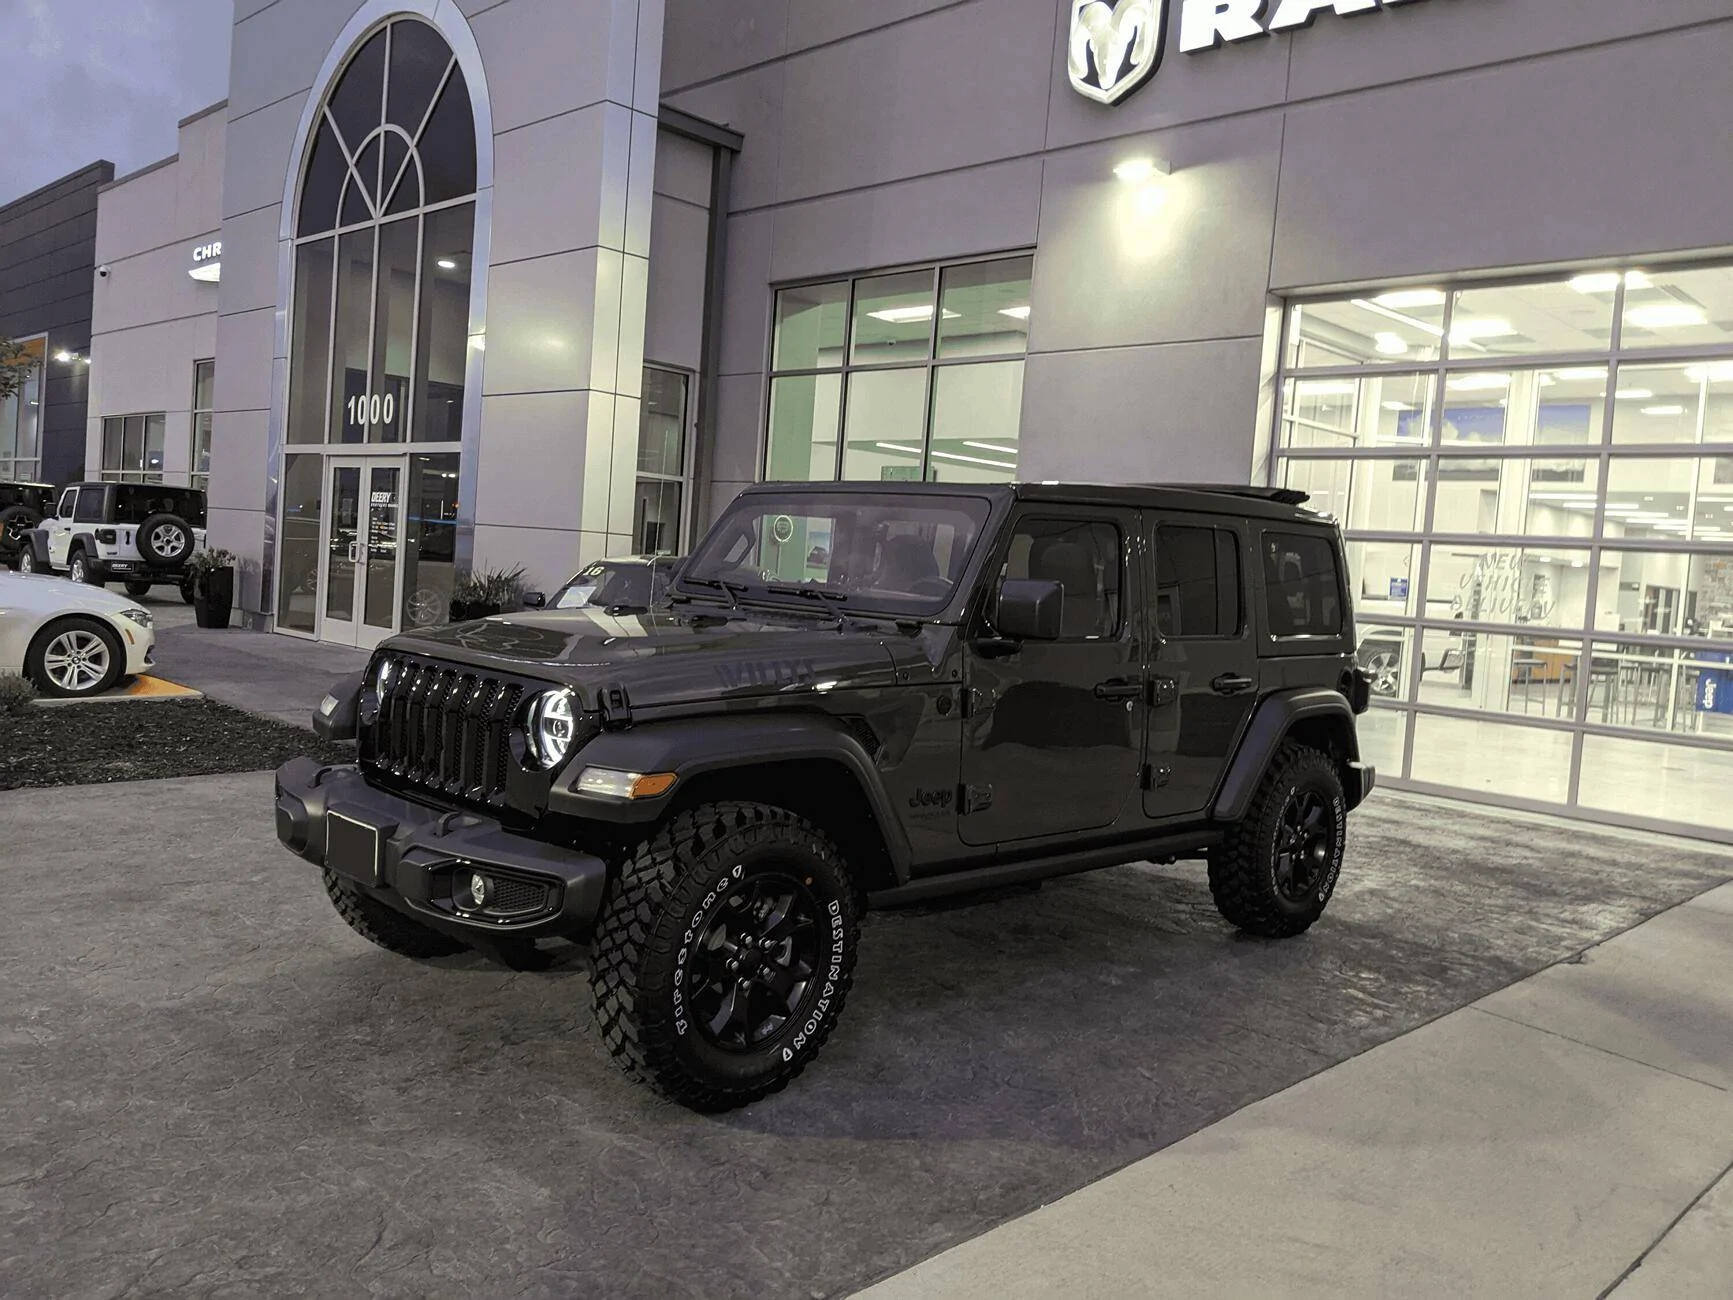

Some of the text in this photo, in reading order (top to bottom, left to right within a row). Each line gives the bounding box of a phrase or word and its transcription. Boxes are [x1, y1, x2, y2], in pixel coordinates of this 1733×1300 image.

[347, 393, 394, 426] 1000
[1459, 572, 1551, 594] VHICE
[909, 787, 953, 809] Jeep
[793, 899, 844, 1050] DESTINATION
